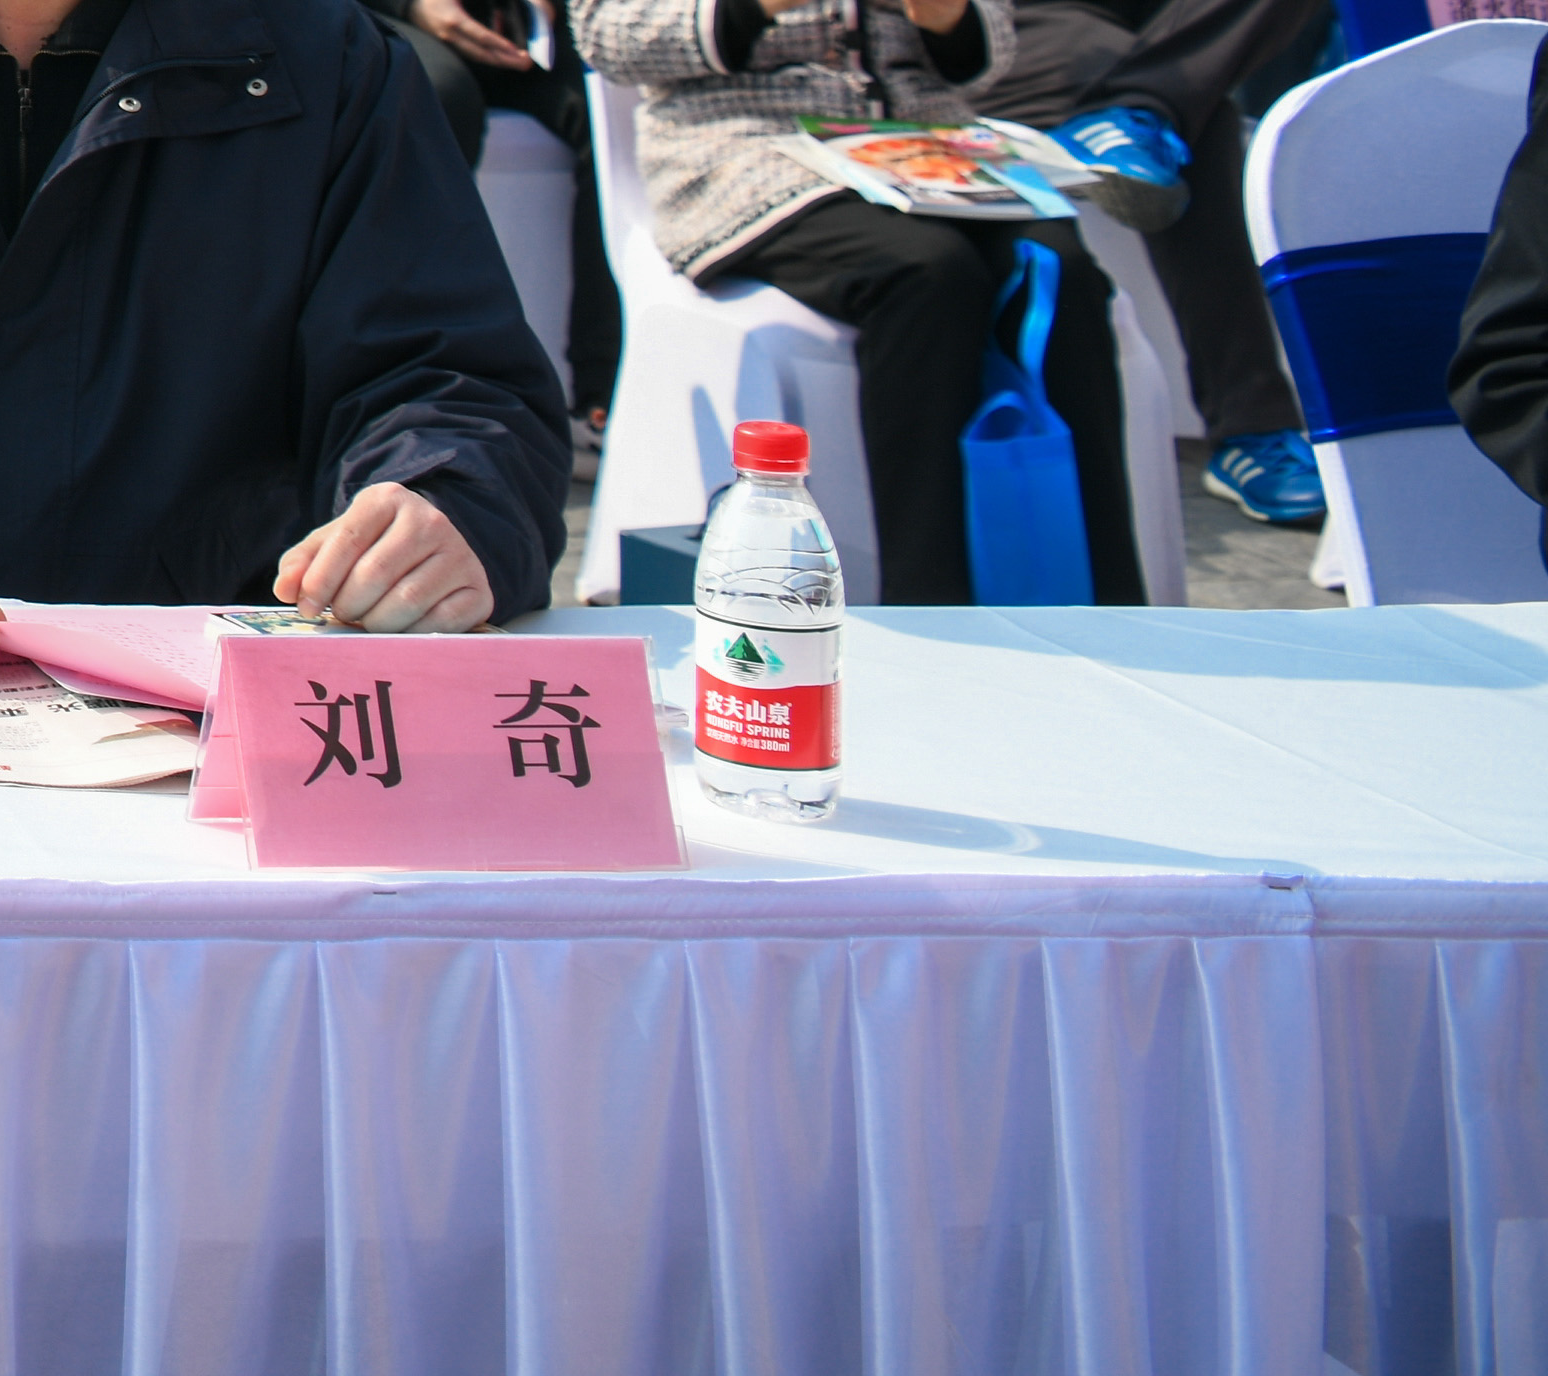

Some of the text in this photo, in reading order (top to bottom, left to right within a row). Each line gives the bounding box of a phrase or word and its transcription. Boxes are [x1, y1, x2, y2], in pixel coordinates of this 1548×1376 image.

[705, 712, 790, 739] NONGFU SPRING
[706, 690, 791, 726] 农夫山泉
[293, 678, 602, 789] 刘 奇
